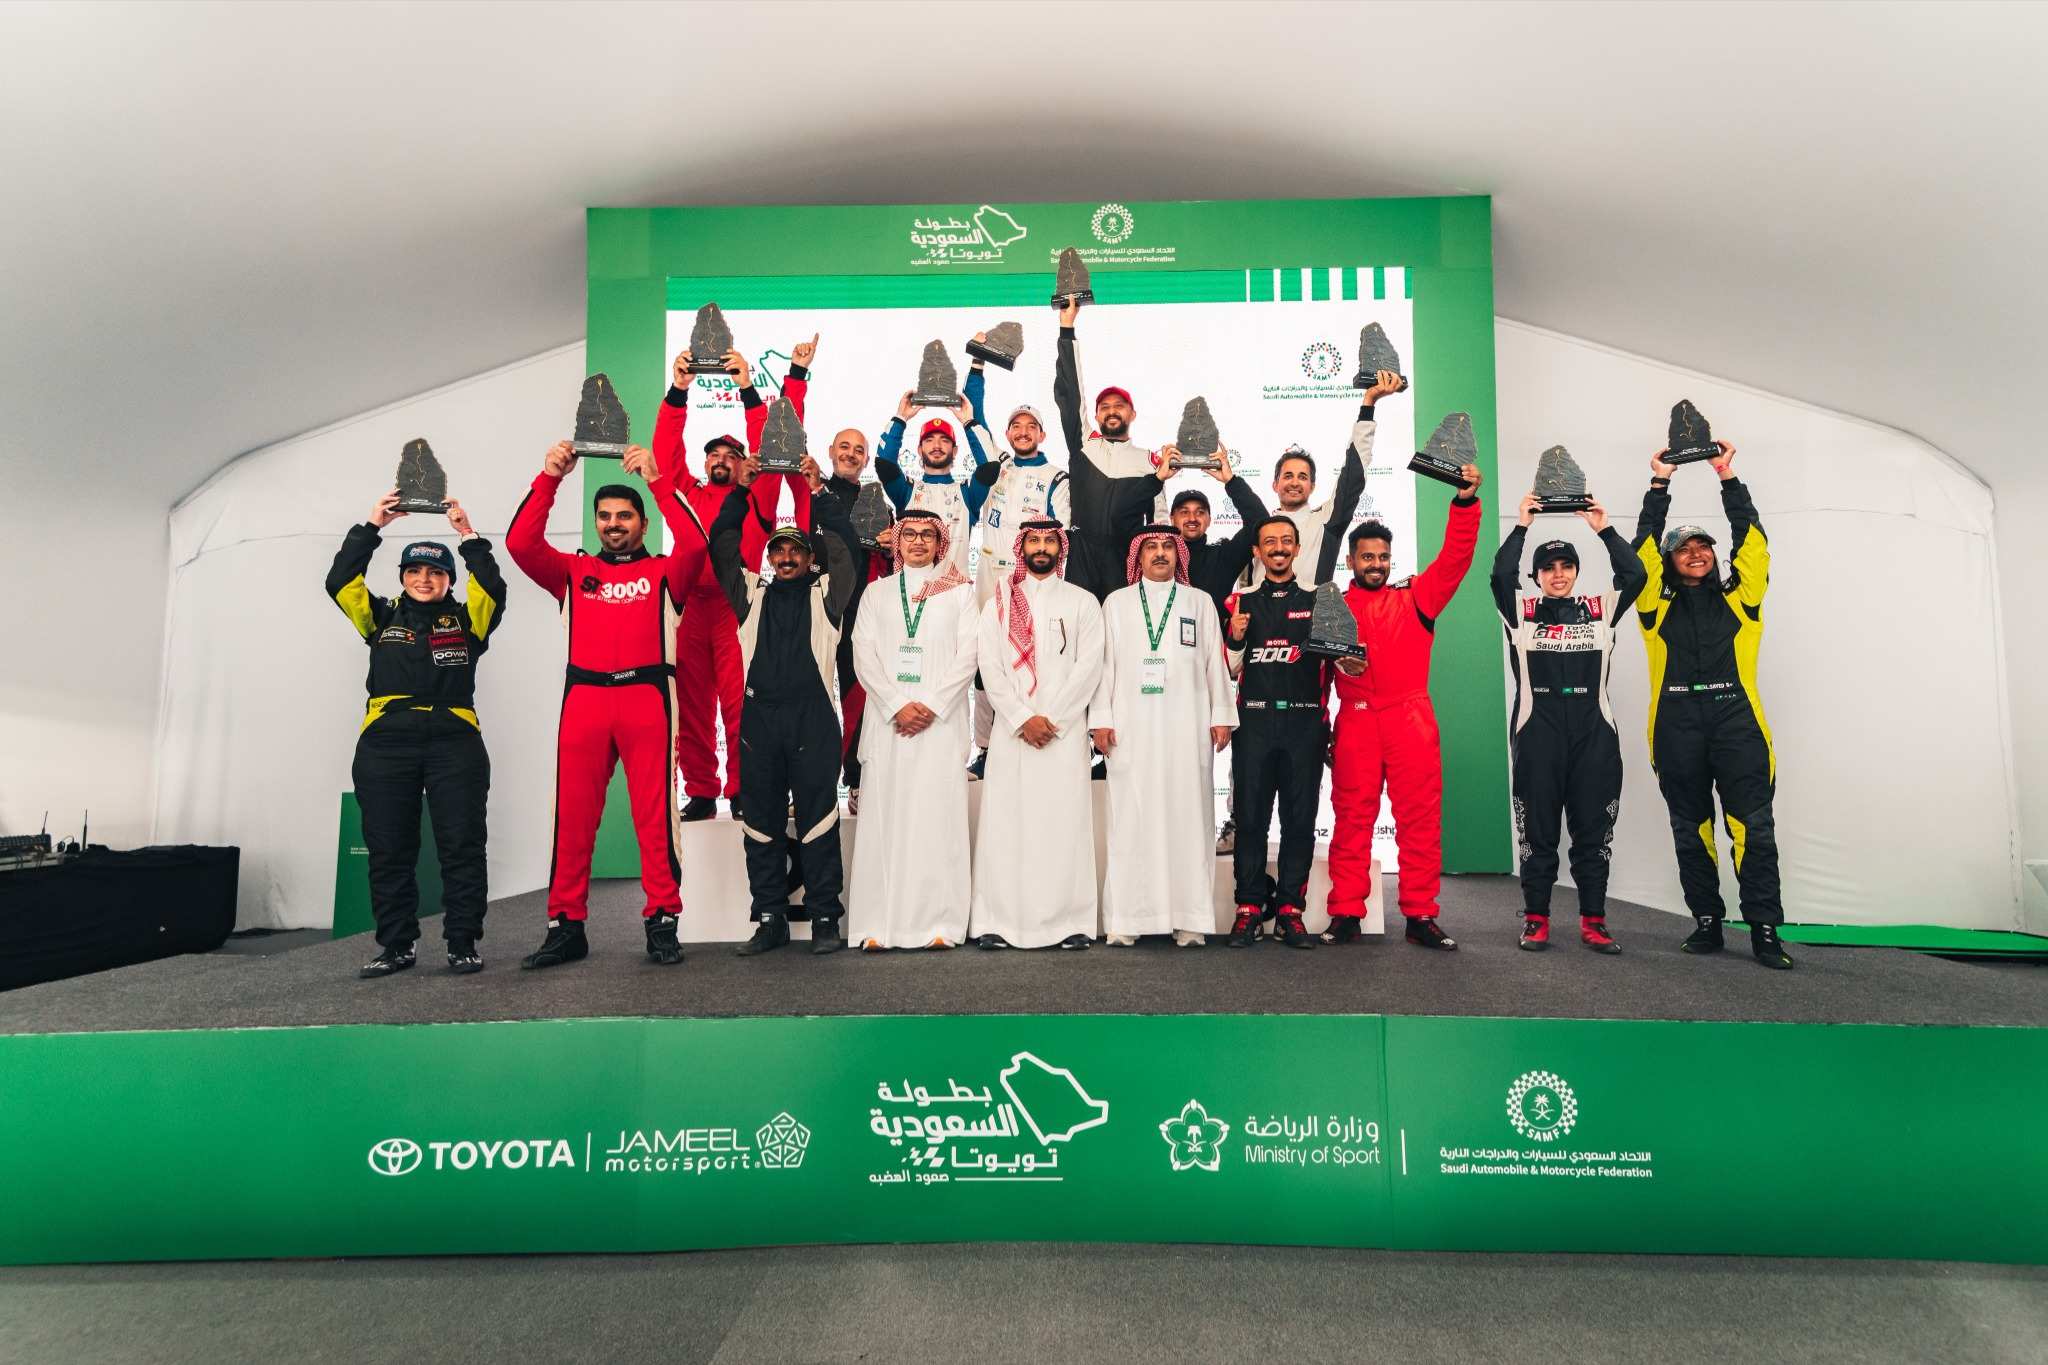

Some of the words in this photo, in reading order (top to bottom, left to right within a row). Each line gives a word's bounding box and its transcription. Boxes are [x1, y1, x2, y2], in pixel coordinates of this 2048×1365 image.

[914, 217, 971, 231] بطولة
[910, 228, 983, 248] السعودية
[950, 248, 1002, 260] تويوتا
[601, 577, 650, 600] 3000
[1536, 642, 1562, 651] Saudi
[1565, 642, 1594, 651] Arabia
[878, 1078, 993, 1107] بطولة
[870, 1104, 1019, 1146] السعودية
[1245, 1115, 1318, 1143] الرياضة
[1327, 1115, 1379, 1144] وزارة
[606, 1128, 750, 1154] JAMEEL
[1526, 1128, 1560, 1142] SAMF
[429, 1139, 575, 1170] TOYOTA
[951, 1146, 1057, 1173] تويوتا
[1245, 1145, 1307, 1167] Ministry
[1311, 1146, 1328, 1164] of
[1333, 1146, 1381, 1167] Sport
[1440, 1147, 1469, 1160] النارية
[1472, 1148, 1519, 1162] والدراجات
[1522, 1149, 1567, 1162] للسيارات
[1569, 1151, 1616, 1163] السعودي
[1619, 1151, 1651, 1162] الاتحاد
[605, 1156, 750, 1175] motorsport
[1441, 1163, 1468, 1174] Saudi
[1471, 1163, 1528, 1175] Automobile
[1530, 1165, 1538, 1175] &
[1540, 1165, 1596, 1178] Motorcycle
[1598, 1166, 1652, 1178] Federation
[915, 1173, 949, 1186] صعود
